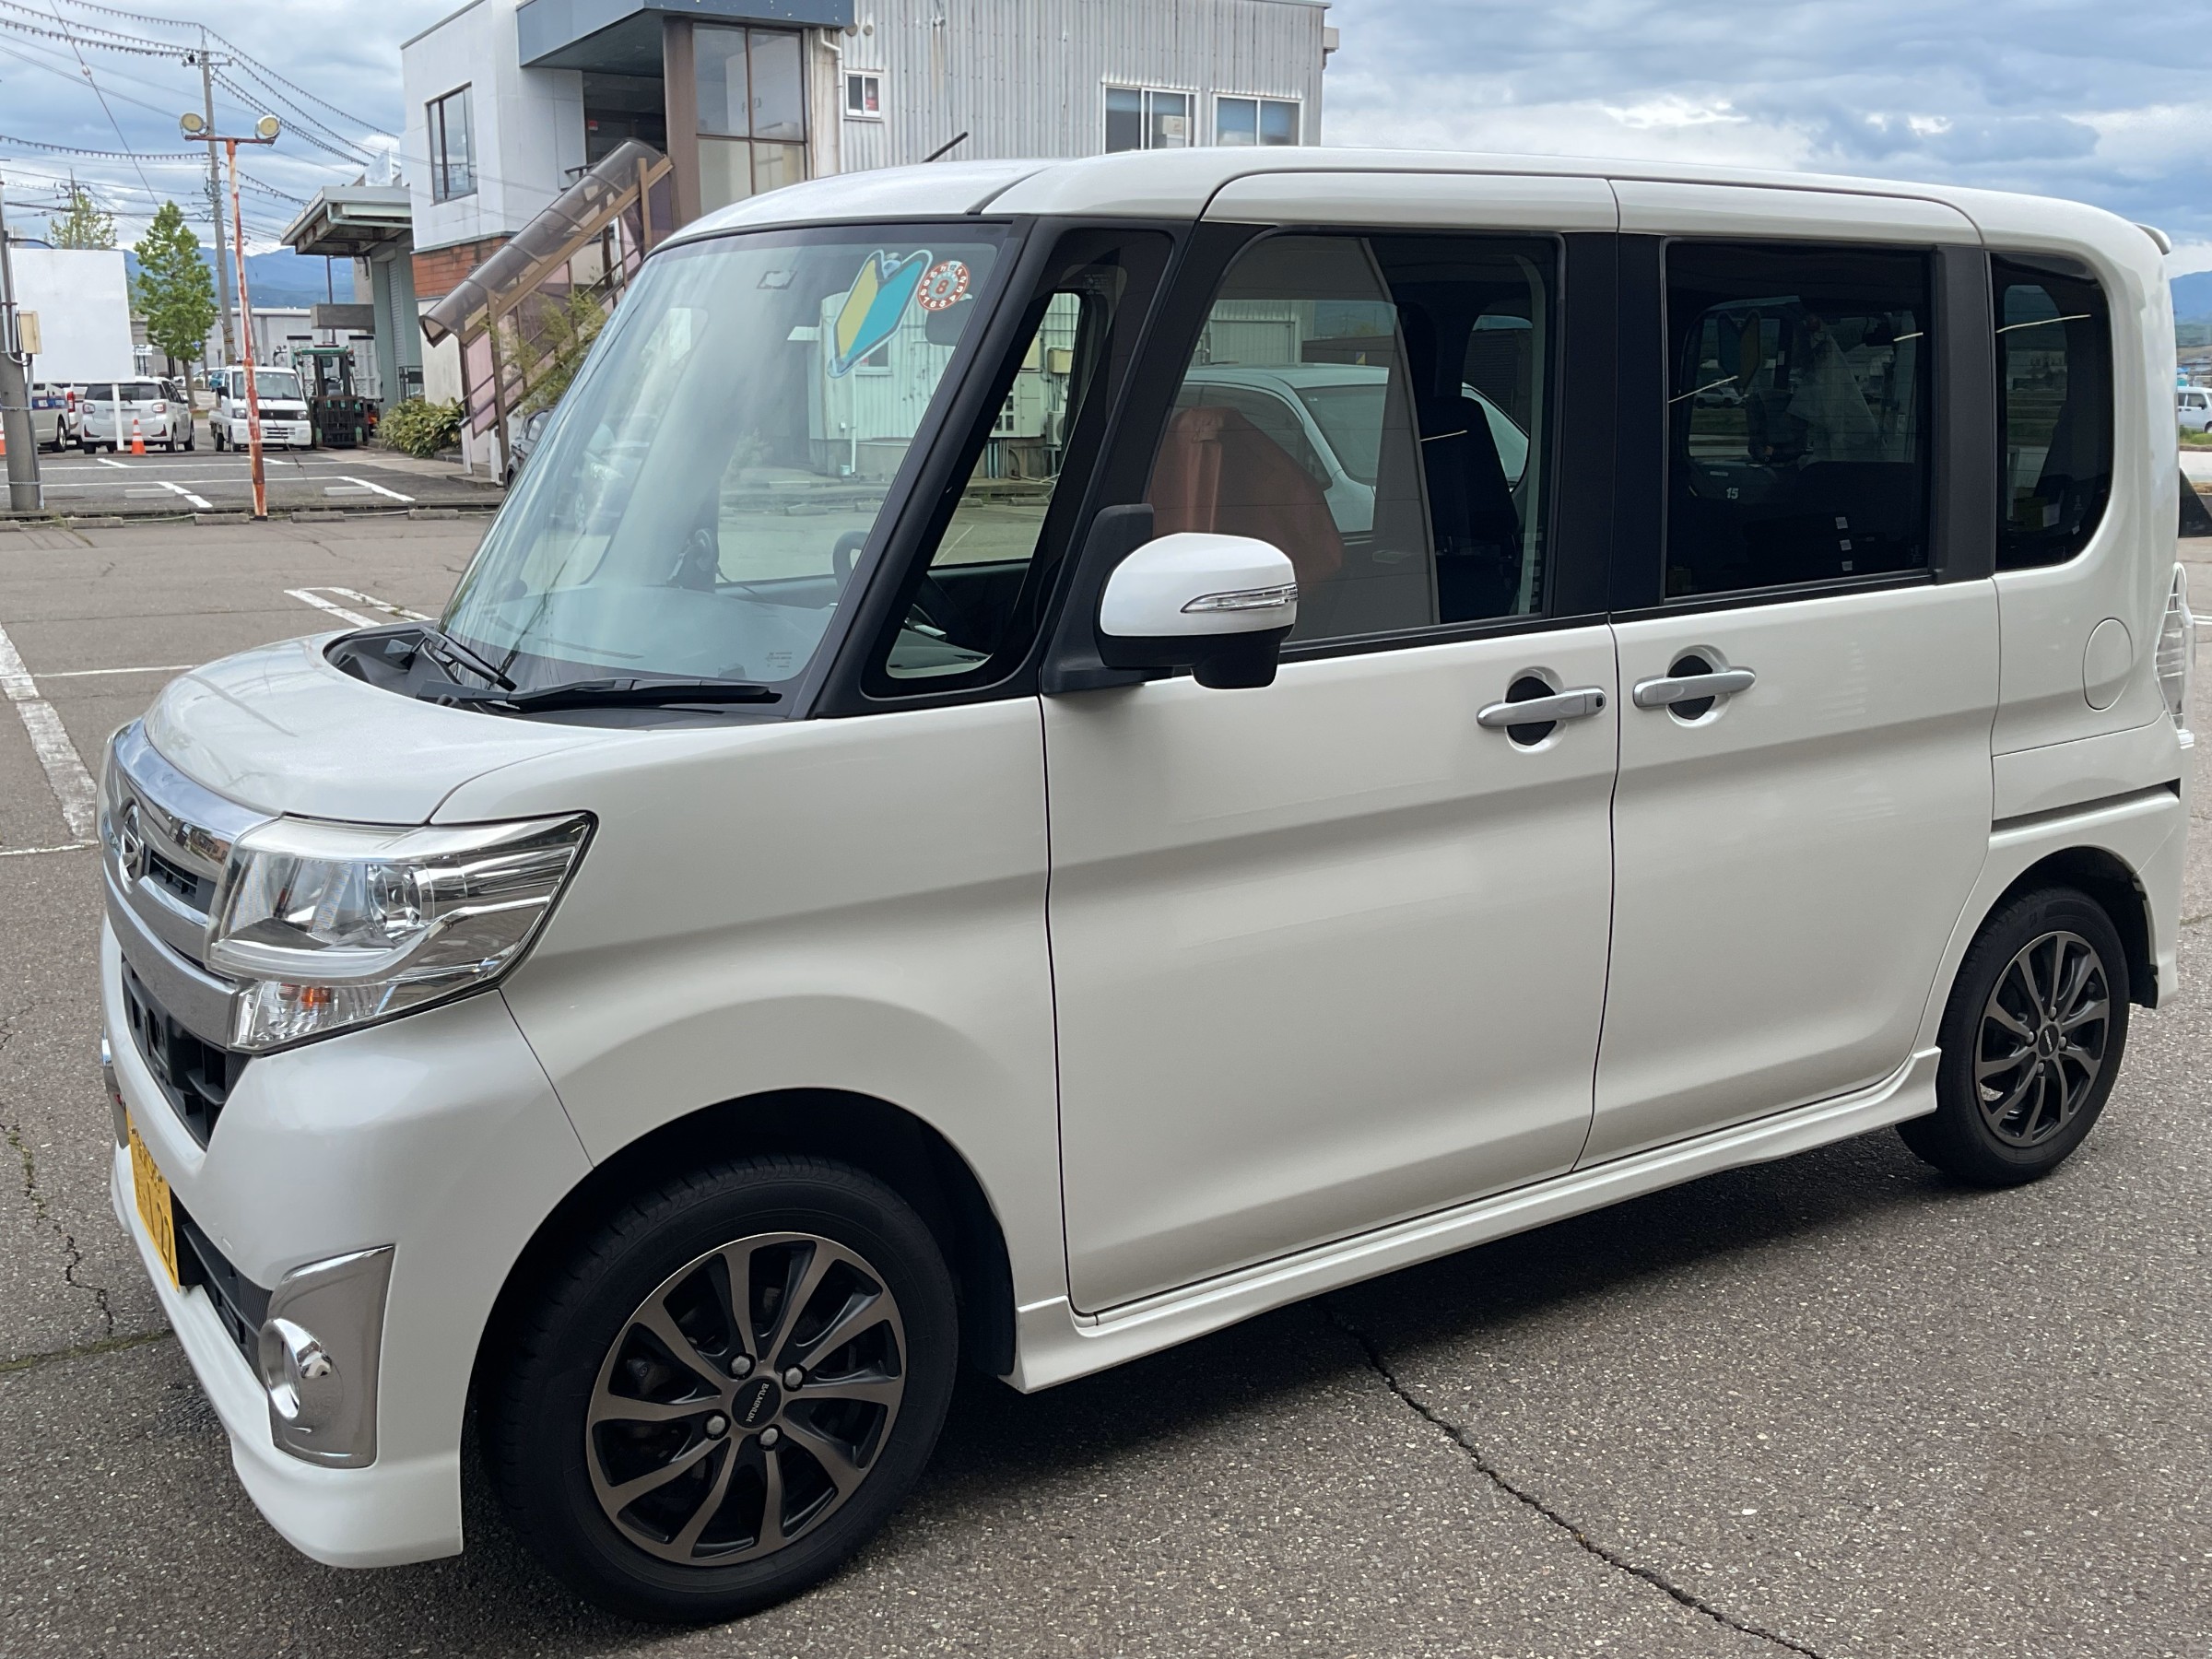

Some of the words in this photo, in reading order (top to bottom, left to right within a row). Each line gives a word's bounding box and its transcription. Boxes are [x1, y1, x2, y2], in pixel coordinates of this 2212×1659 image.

[959, 276, 967, 284] 2
[935, 279, 948, 294] 8
[923, 296, 930, 304] 7
[938, 300, 947, 308] 5
[1726, 487, 1739, 500] 15
